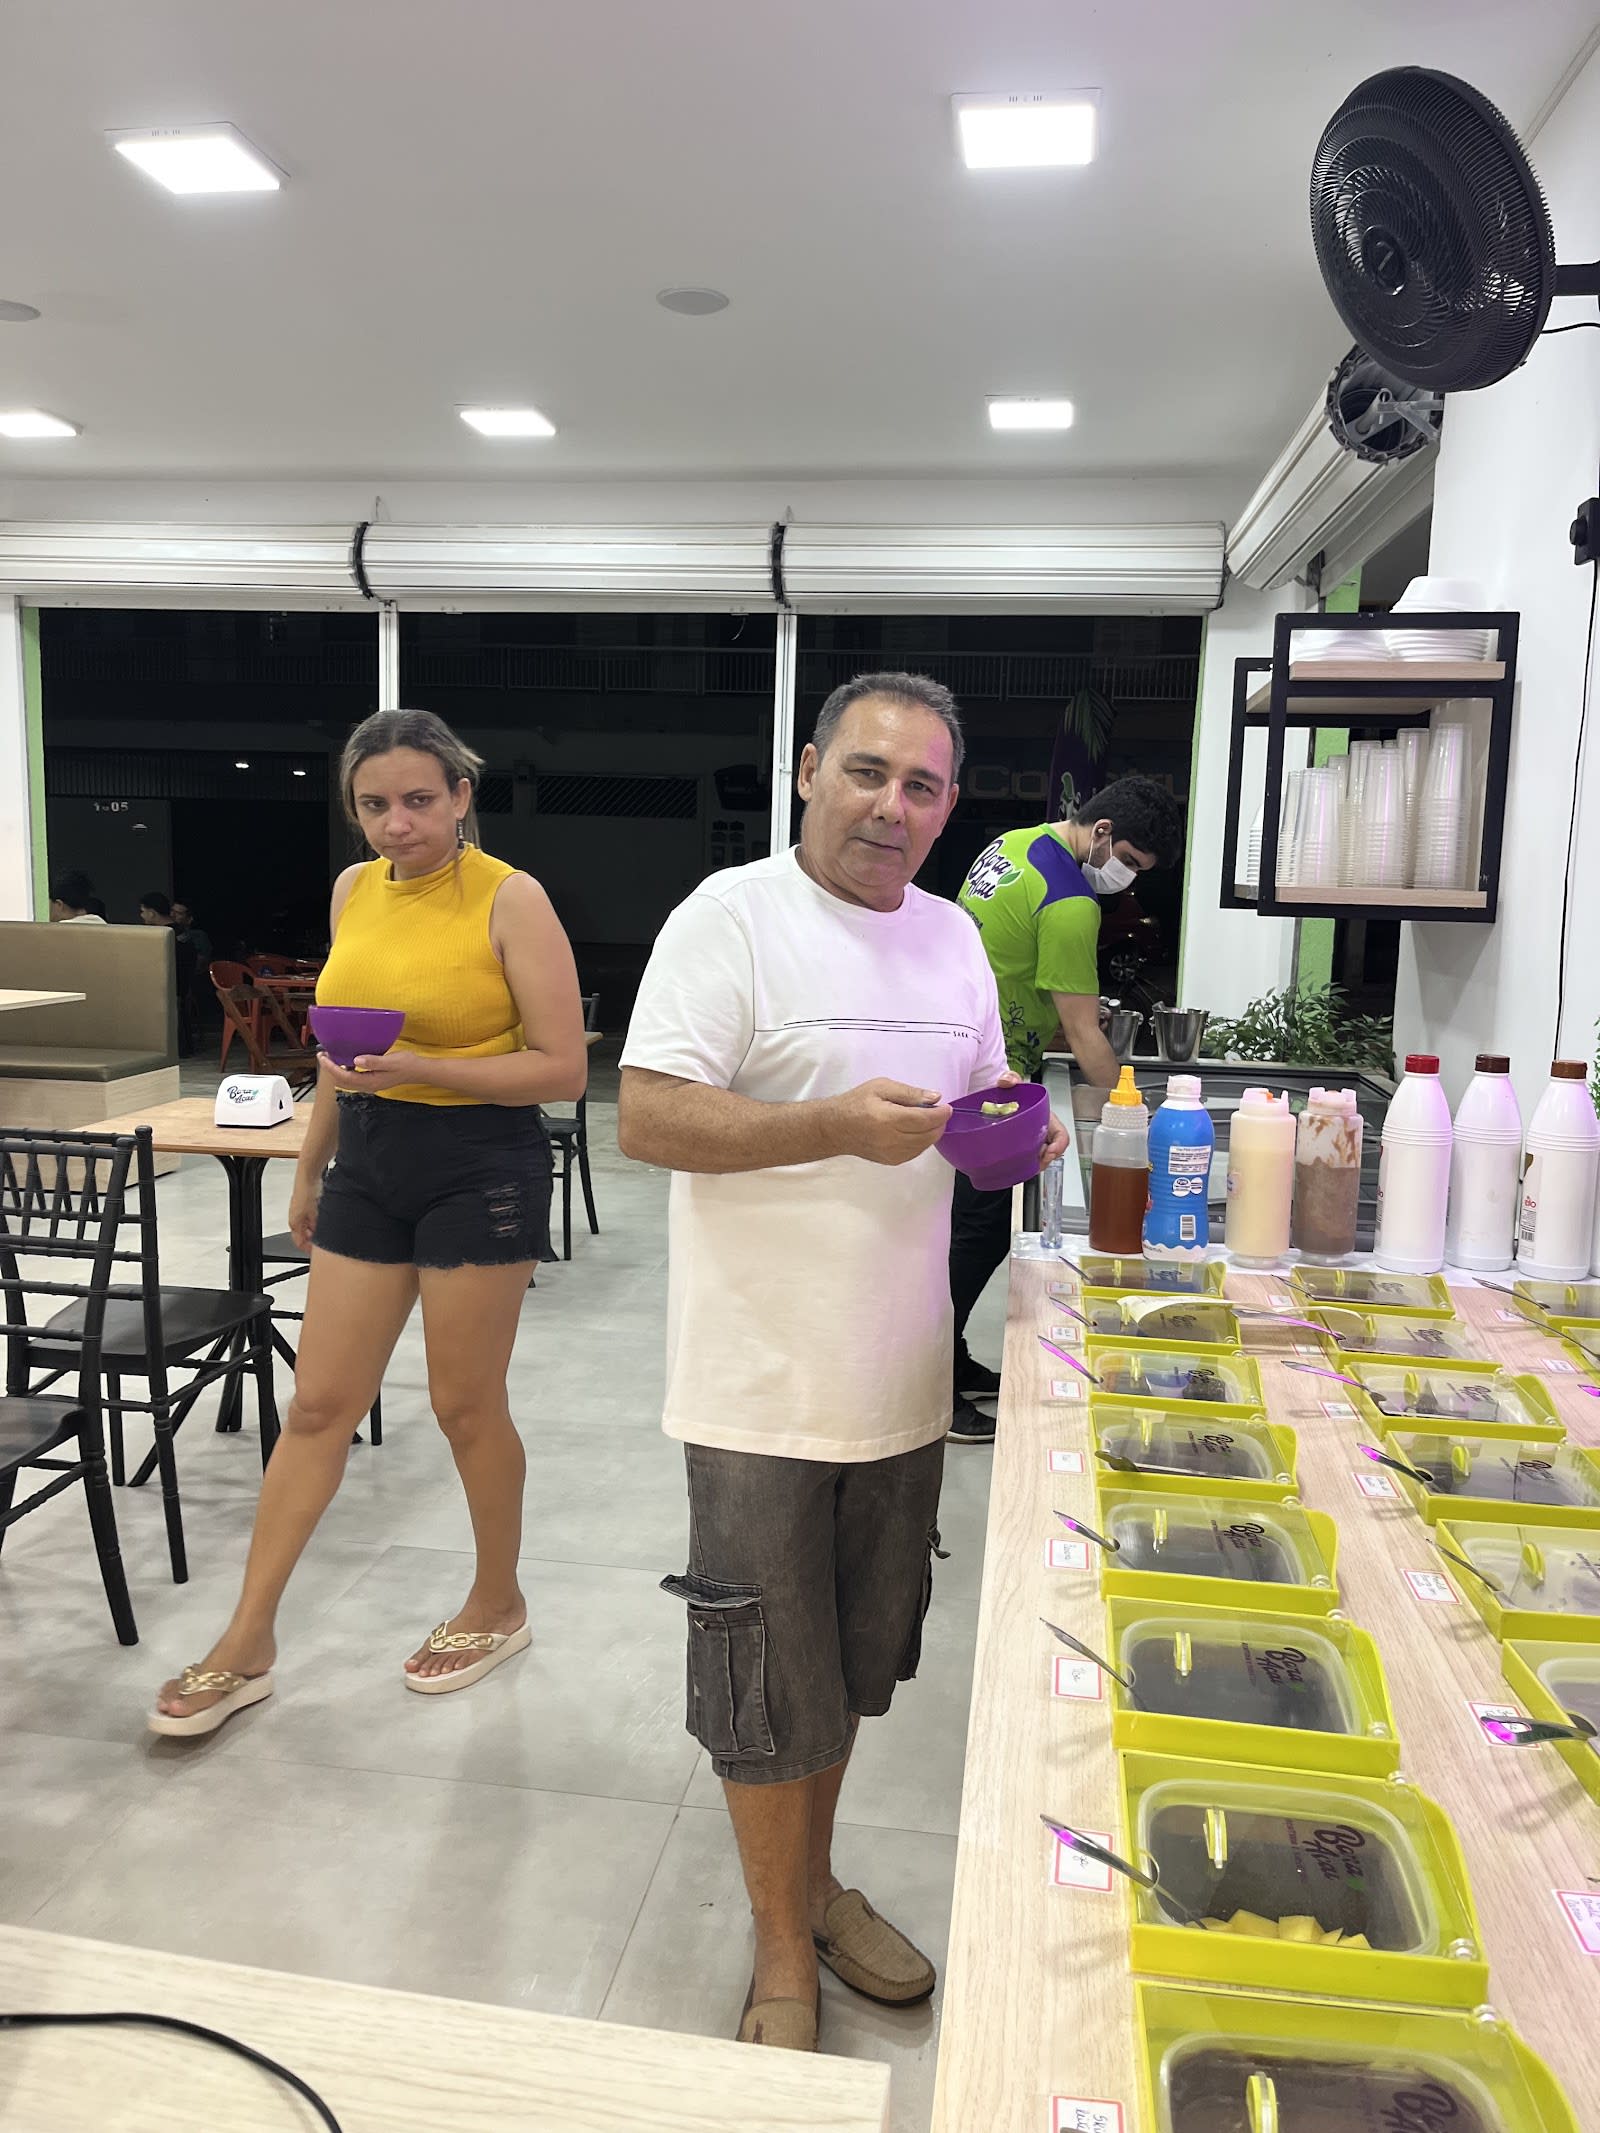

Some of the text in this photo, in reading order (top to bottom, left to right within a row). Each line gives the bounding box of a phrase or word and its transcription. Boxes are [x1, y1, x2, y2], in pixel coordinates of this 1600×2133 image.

[967, 839, 1012, 881] Bora
[1230, 1522, 1265, 1548] Bora
[1265, 1647, 1306, 1683] Bora
[1314, 1824, 1366, 1878] Bora
